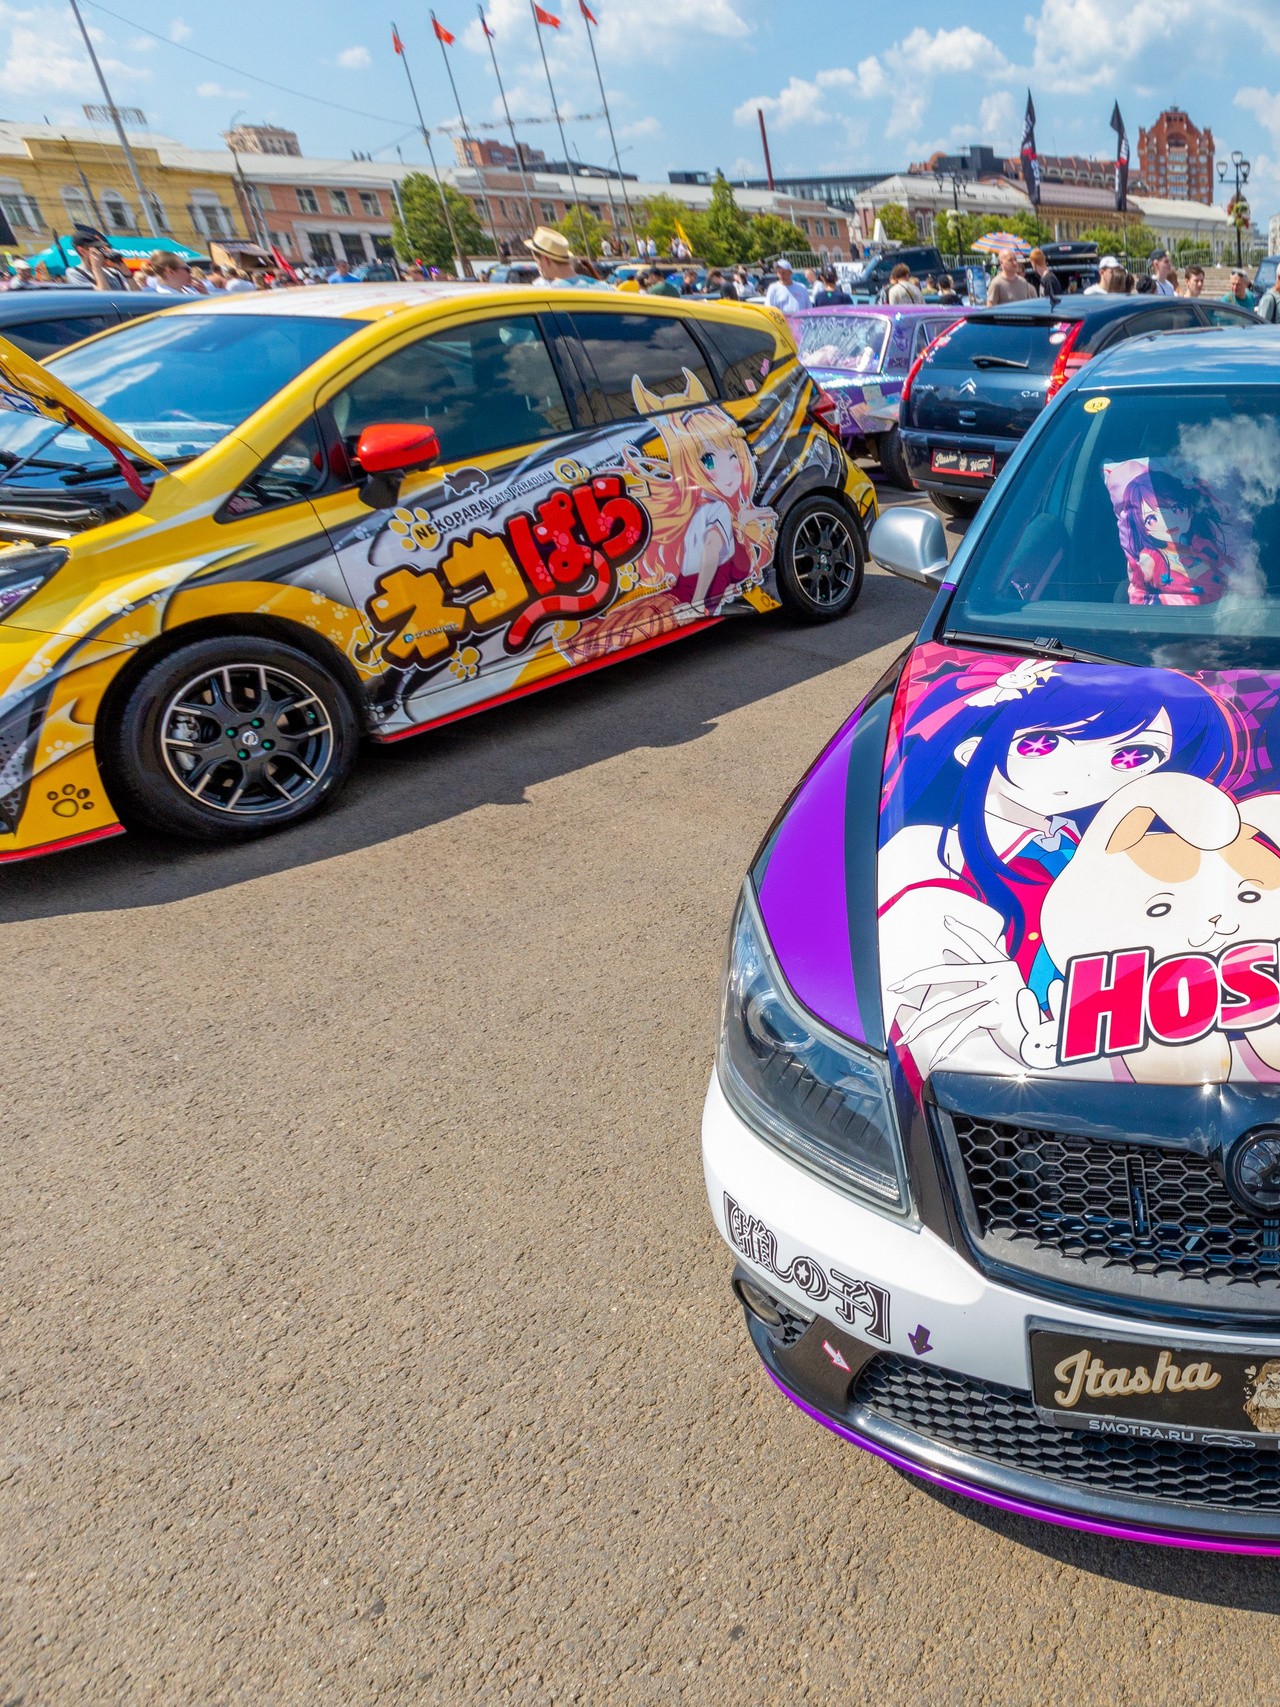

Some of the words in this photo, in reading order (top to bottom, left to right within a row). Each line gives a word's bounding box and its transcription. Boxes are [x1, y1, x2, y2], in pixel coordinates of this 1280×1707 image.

[415, 499, 489, 540] NEKOPARA
[488, 489, 512, 507] CATS
[369, 475, 645, 661] ネコぱら
[1054, 1348, 1221, 1407] Itasha
[1088, 1419, 1195, 1443] SMOTRA.RU
